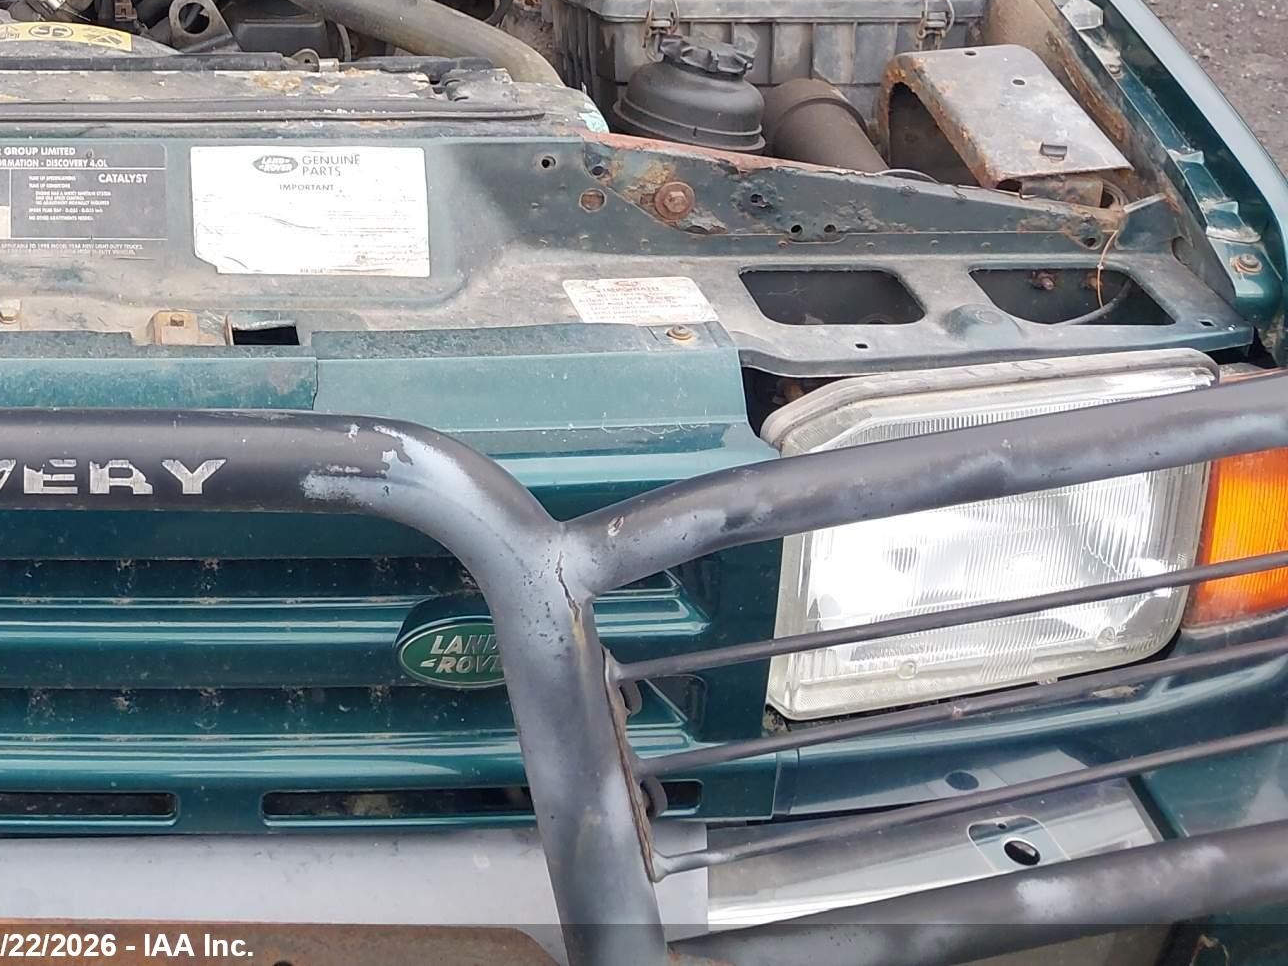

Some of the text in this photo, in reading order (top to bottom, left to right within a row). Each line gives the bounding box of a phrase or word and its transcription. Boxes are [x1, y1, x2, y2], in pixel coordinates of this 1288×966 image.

[4, 147, 38, 156] GROUP
[41, 147, 75, 156] LIMITED
[46, 159, 88, 167] DISCOVERY
[302, 154, 360, 164] GENUINE
[303, 166, 340, 176] PARTS
[98, 174, 148, 183] CATALYST
